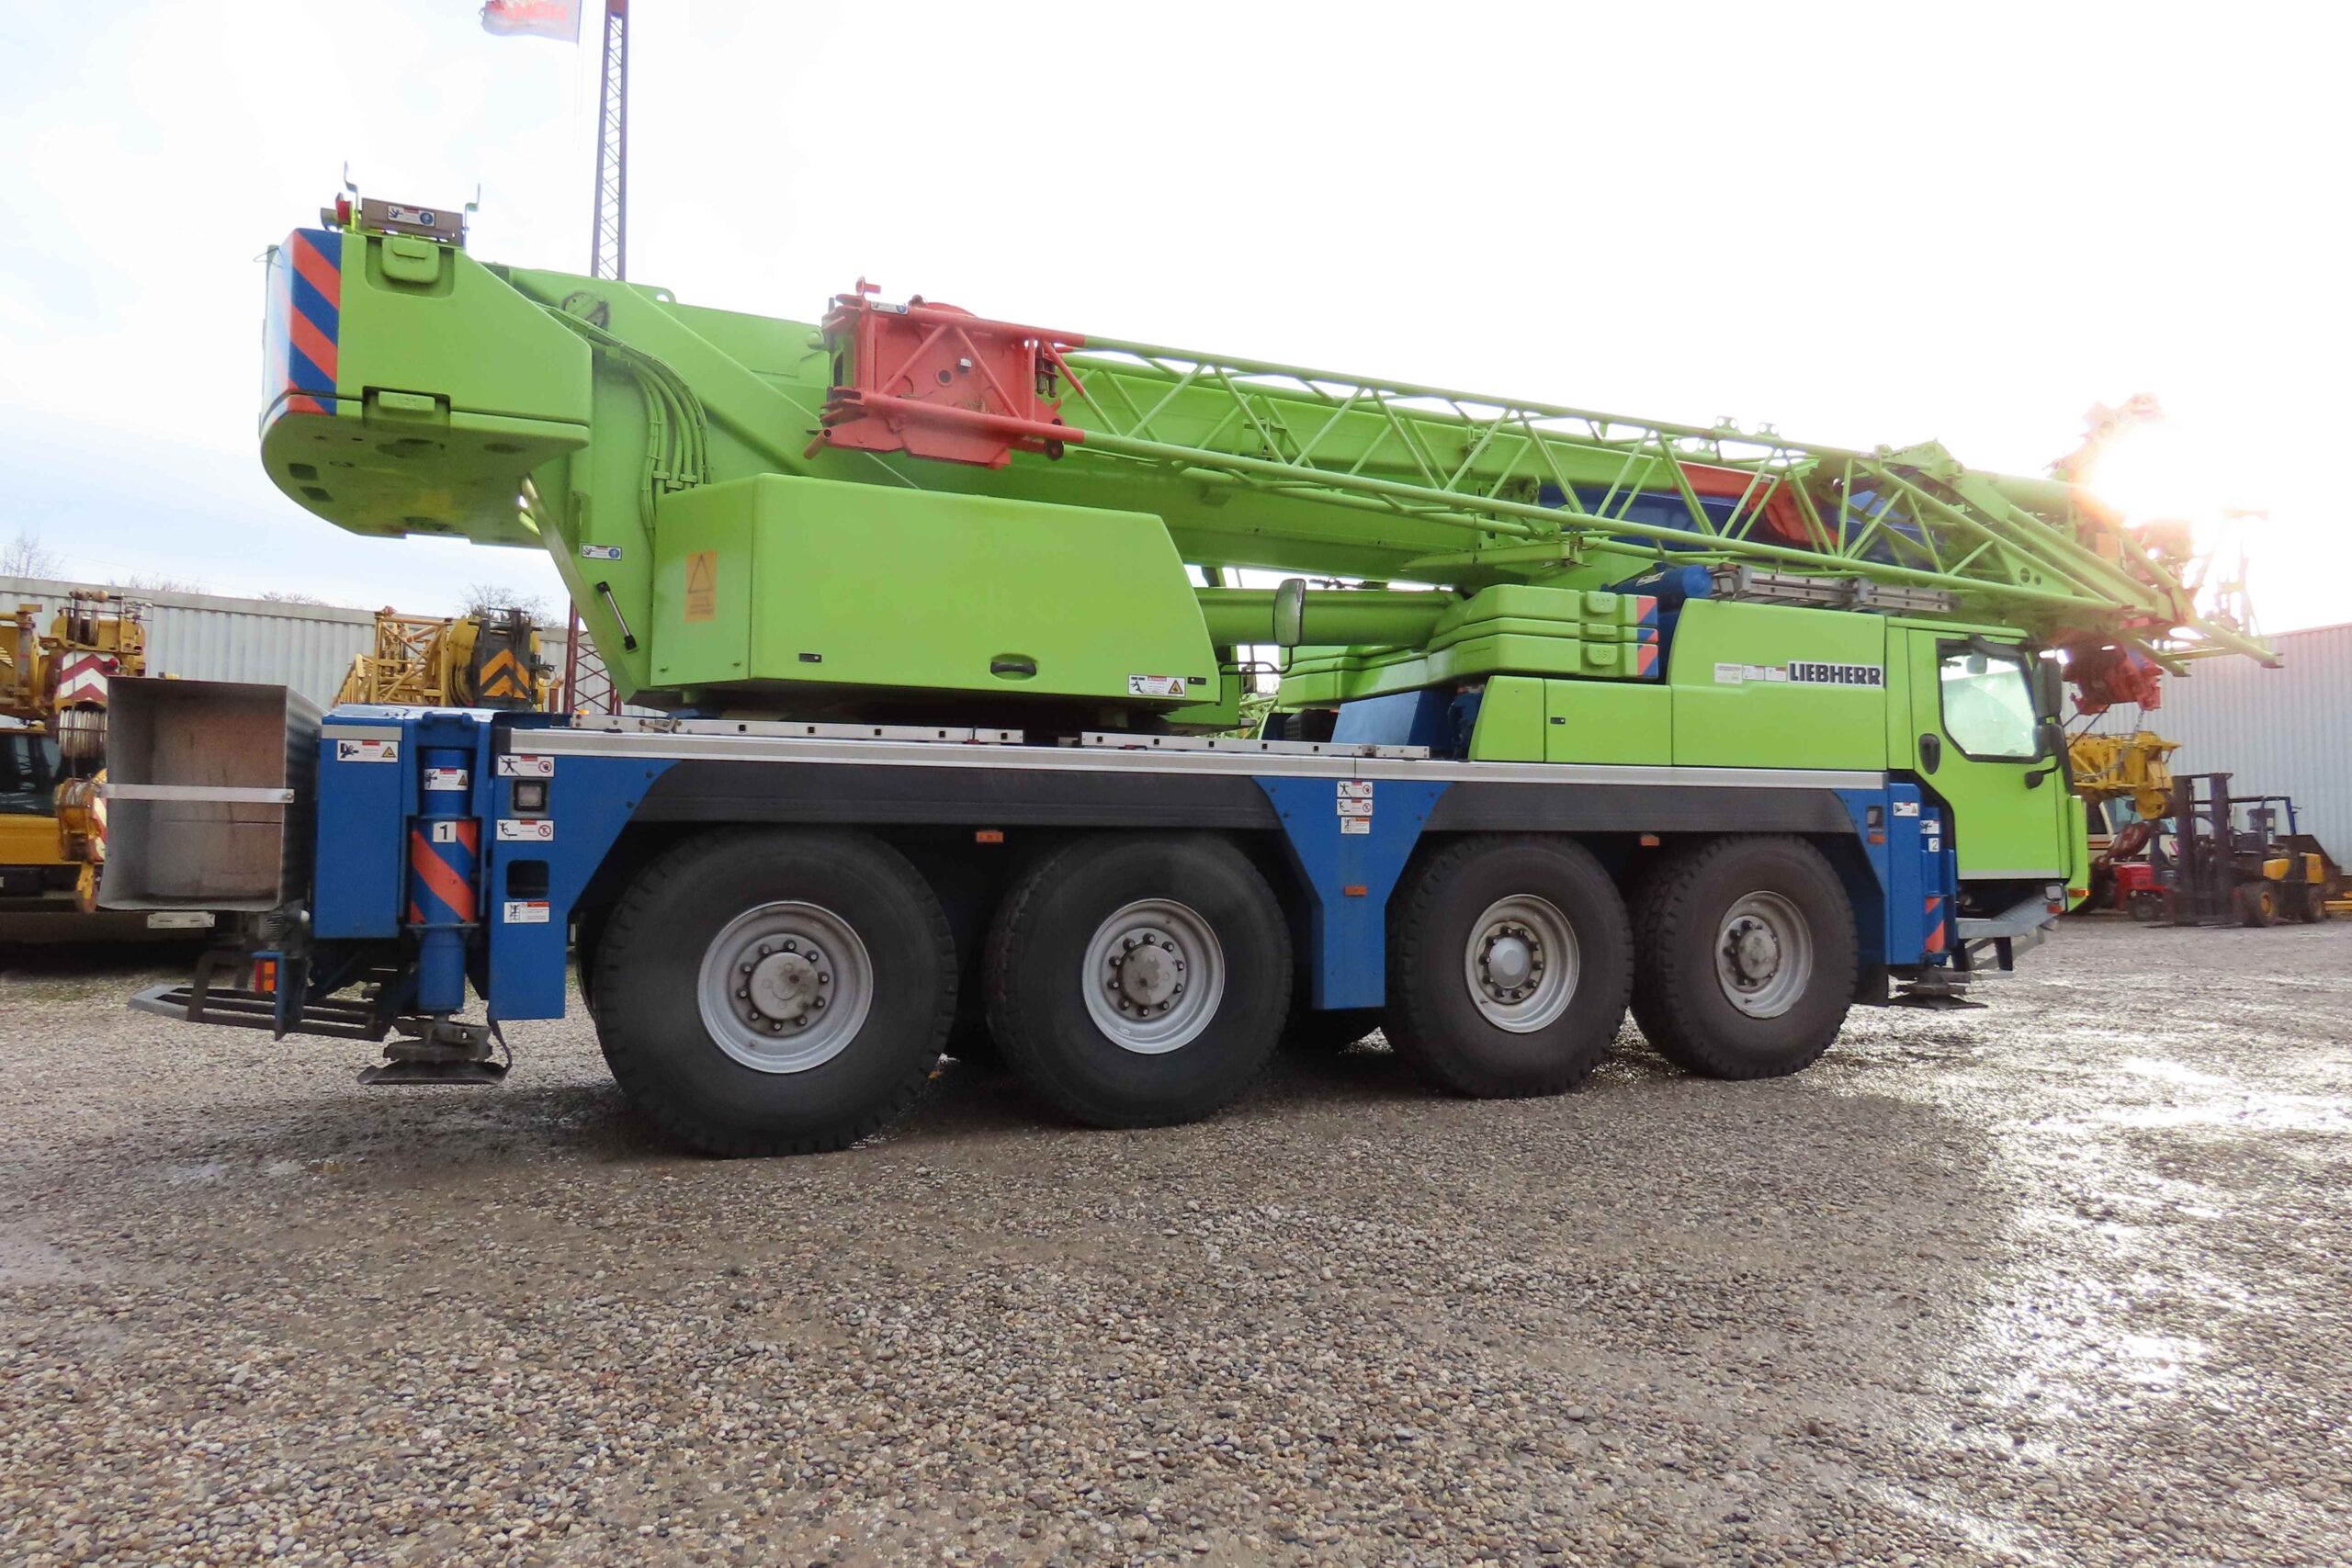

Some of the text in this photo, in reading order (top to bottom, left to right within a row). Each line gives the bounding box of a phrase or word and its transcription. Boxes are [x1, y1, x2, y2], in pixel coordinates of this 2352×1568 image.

[1789, 662, 1881, 685] LIEBHERR
[439, 824, 448, 840] 1
[1931, 839, 1939, 851] 2
